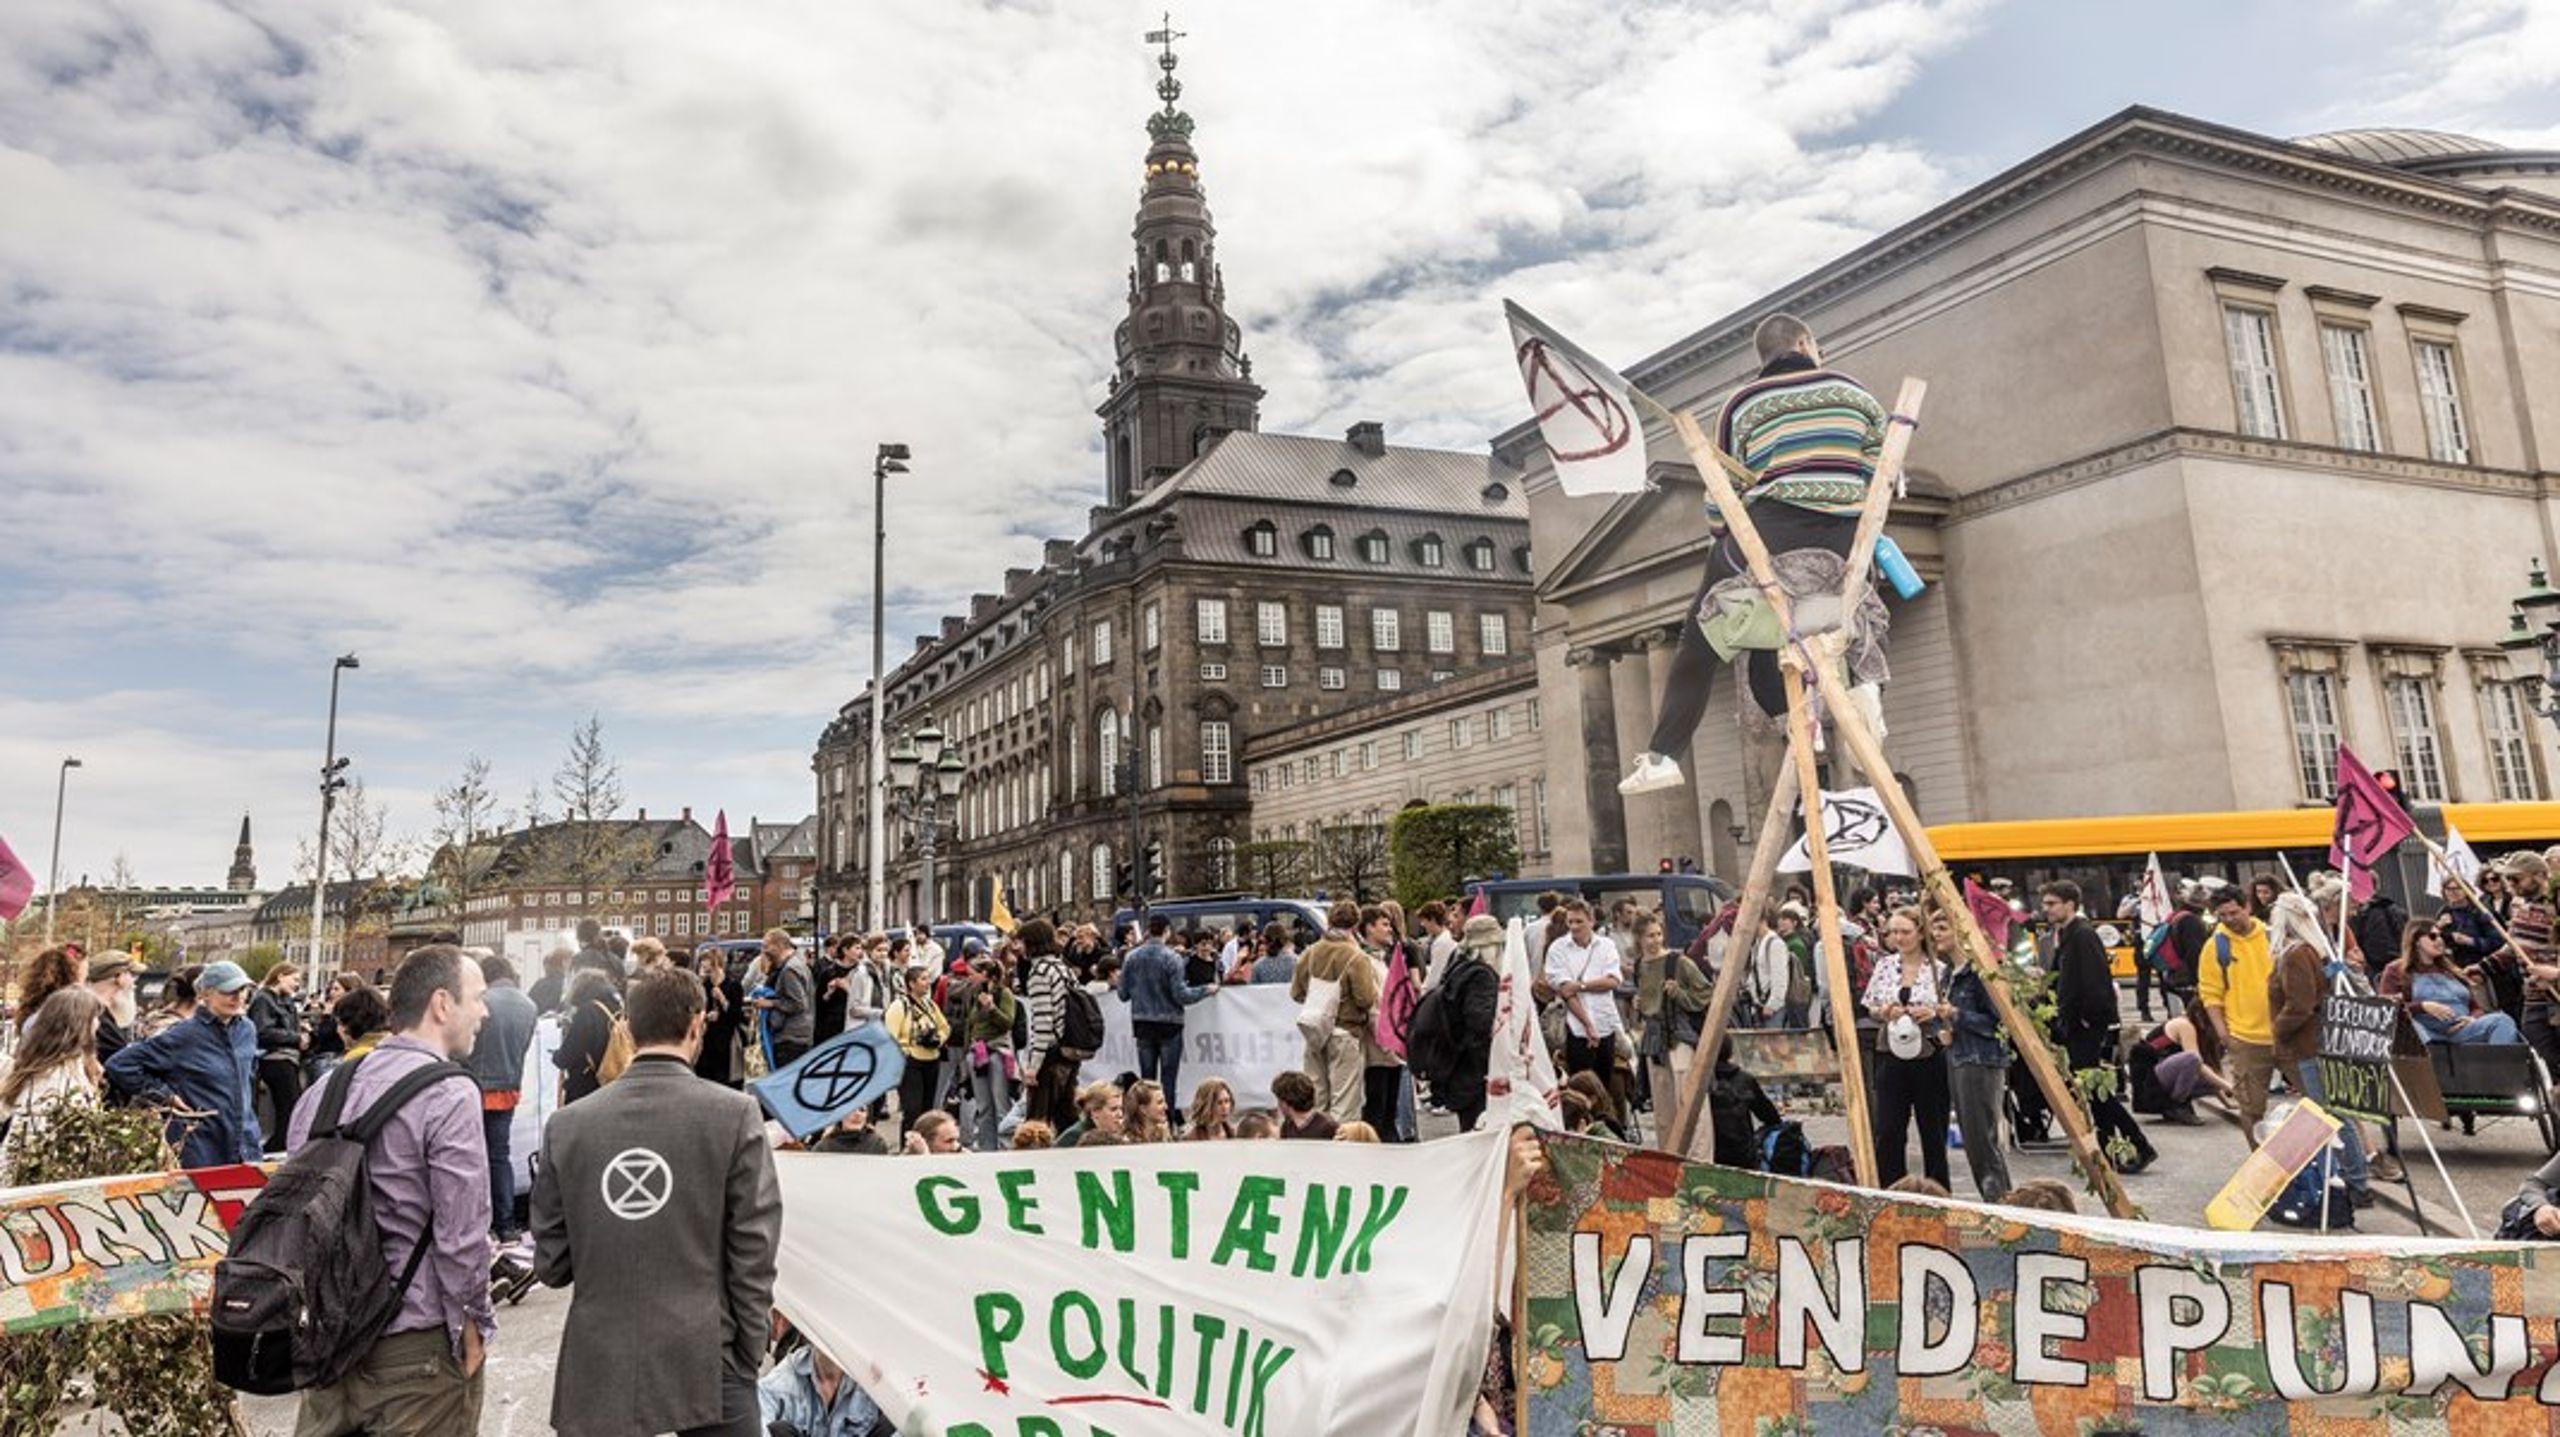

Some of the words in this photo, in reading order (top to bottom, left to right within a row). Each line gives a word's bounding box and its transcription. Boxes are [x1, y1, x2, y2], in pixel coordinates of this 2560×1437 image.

[0, 1188, 264, 1286] UNK
[915, 1168, 1409, 1279] GENTÆNK
[973, 1290, 1296, 1437] POLITIK
[1571, 1231, 2560, 1405] VENDEPUN
